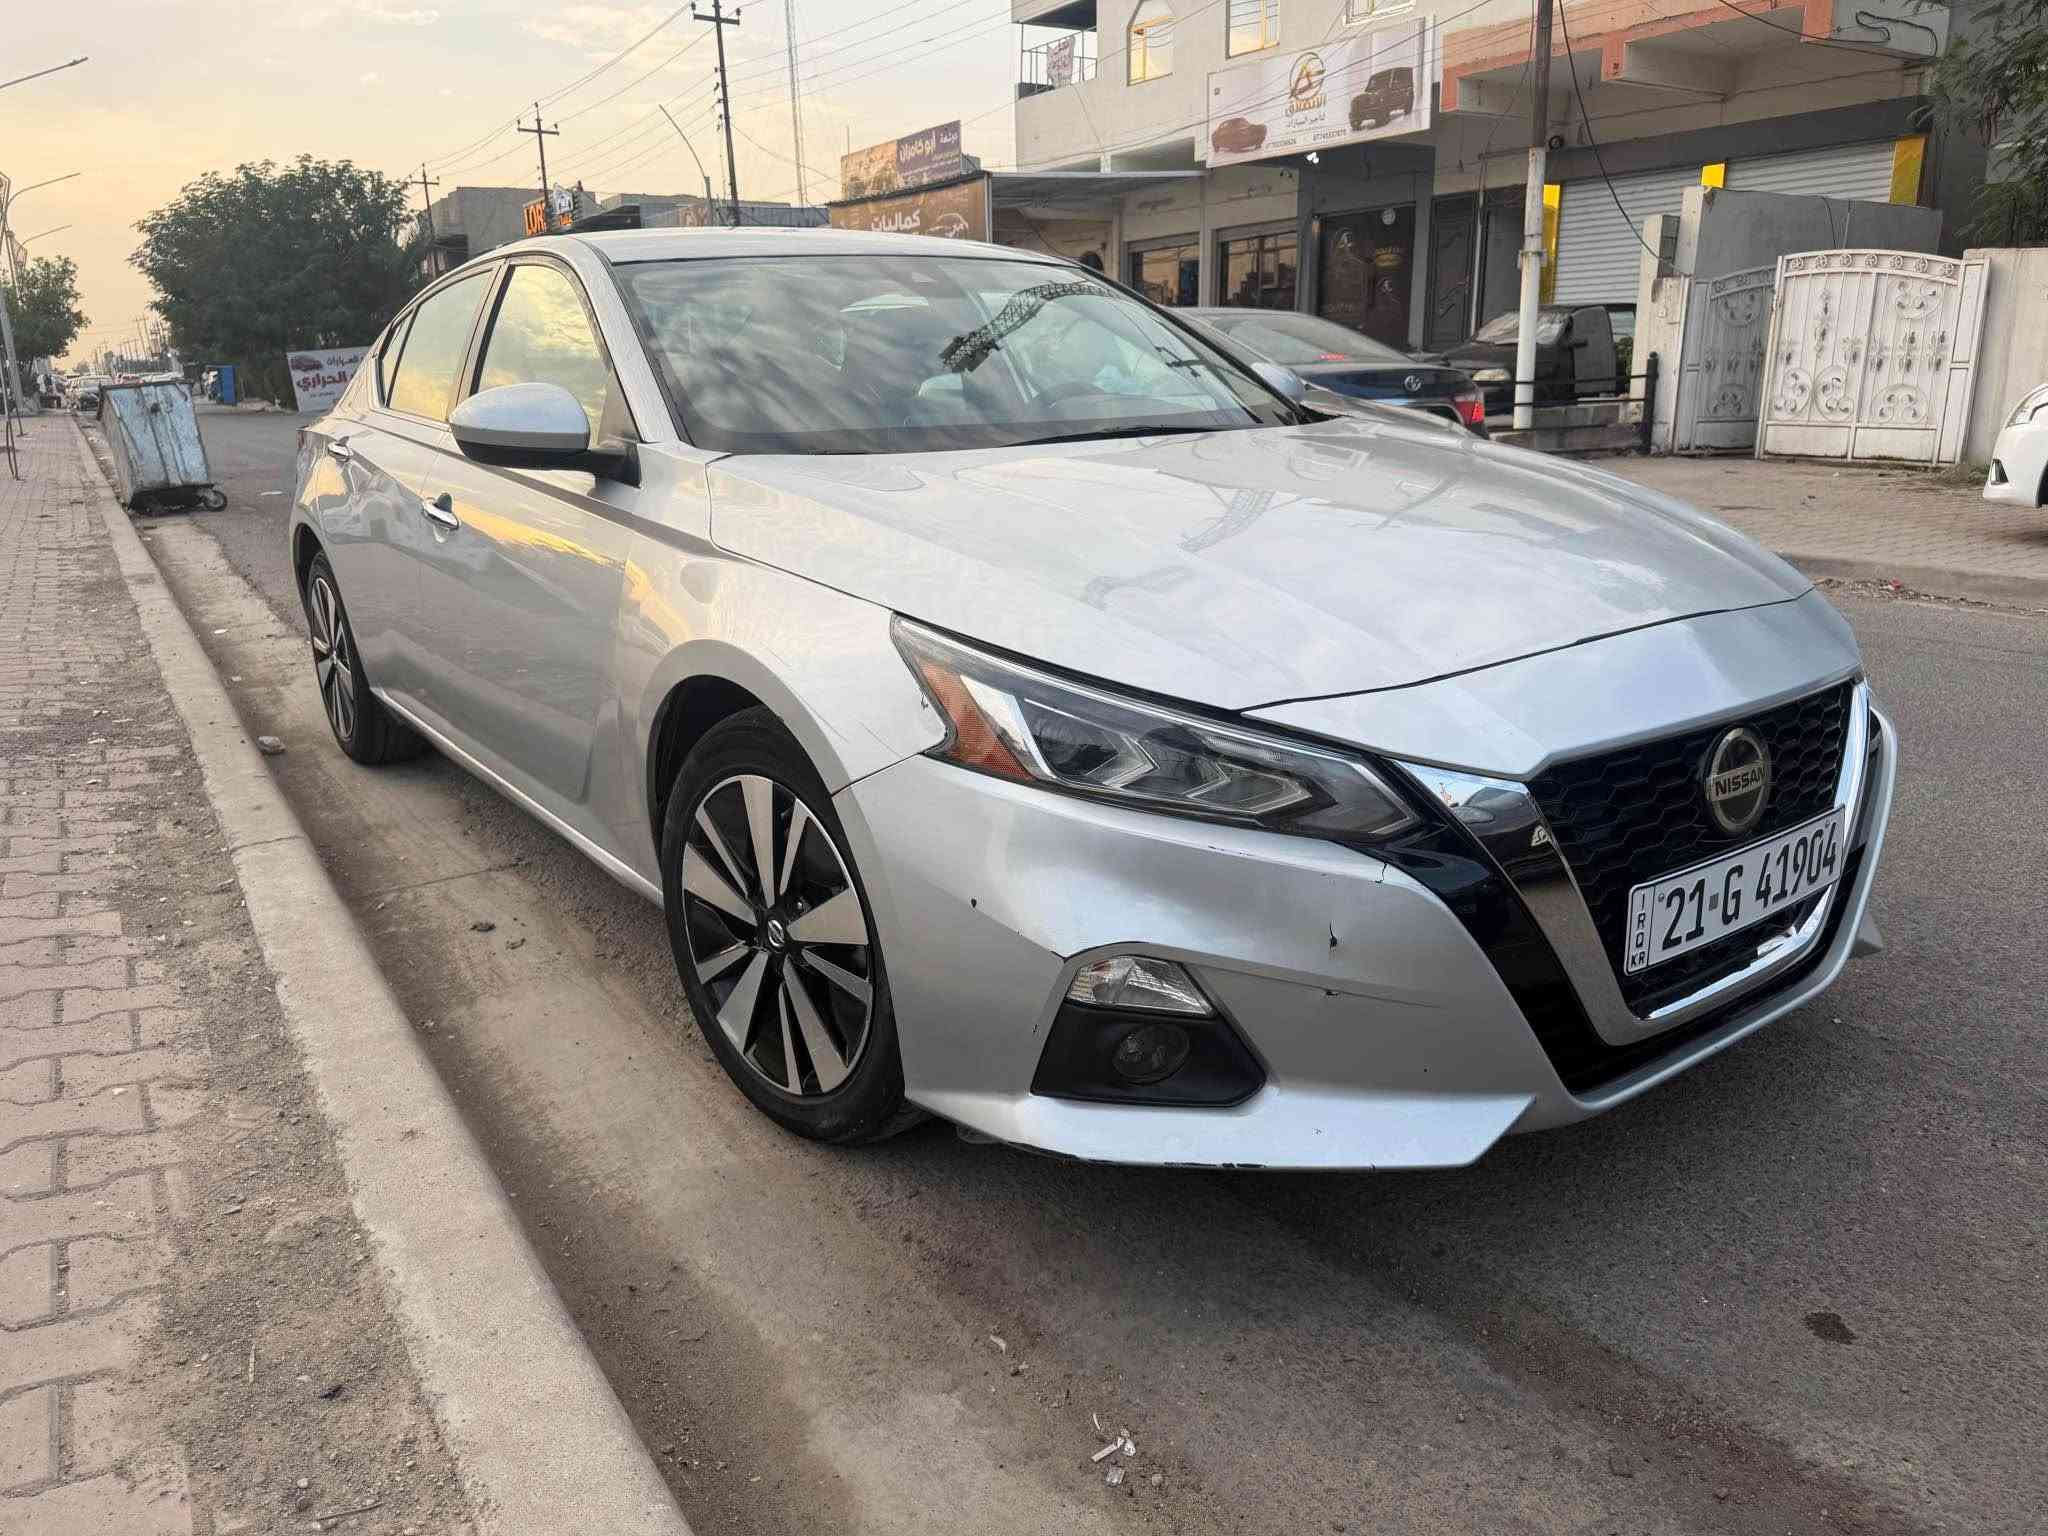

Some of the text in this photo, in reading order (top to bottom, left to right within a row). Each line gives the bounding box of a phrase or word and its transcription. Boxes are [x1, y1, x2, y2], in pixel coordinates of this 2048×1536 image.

[1715, 765, 1766, 796] NISSAN
[1755, 822, 1837, 909] 41904
[1630, 951, 1646, 968] KR
